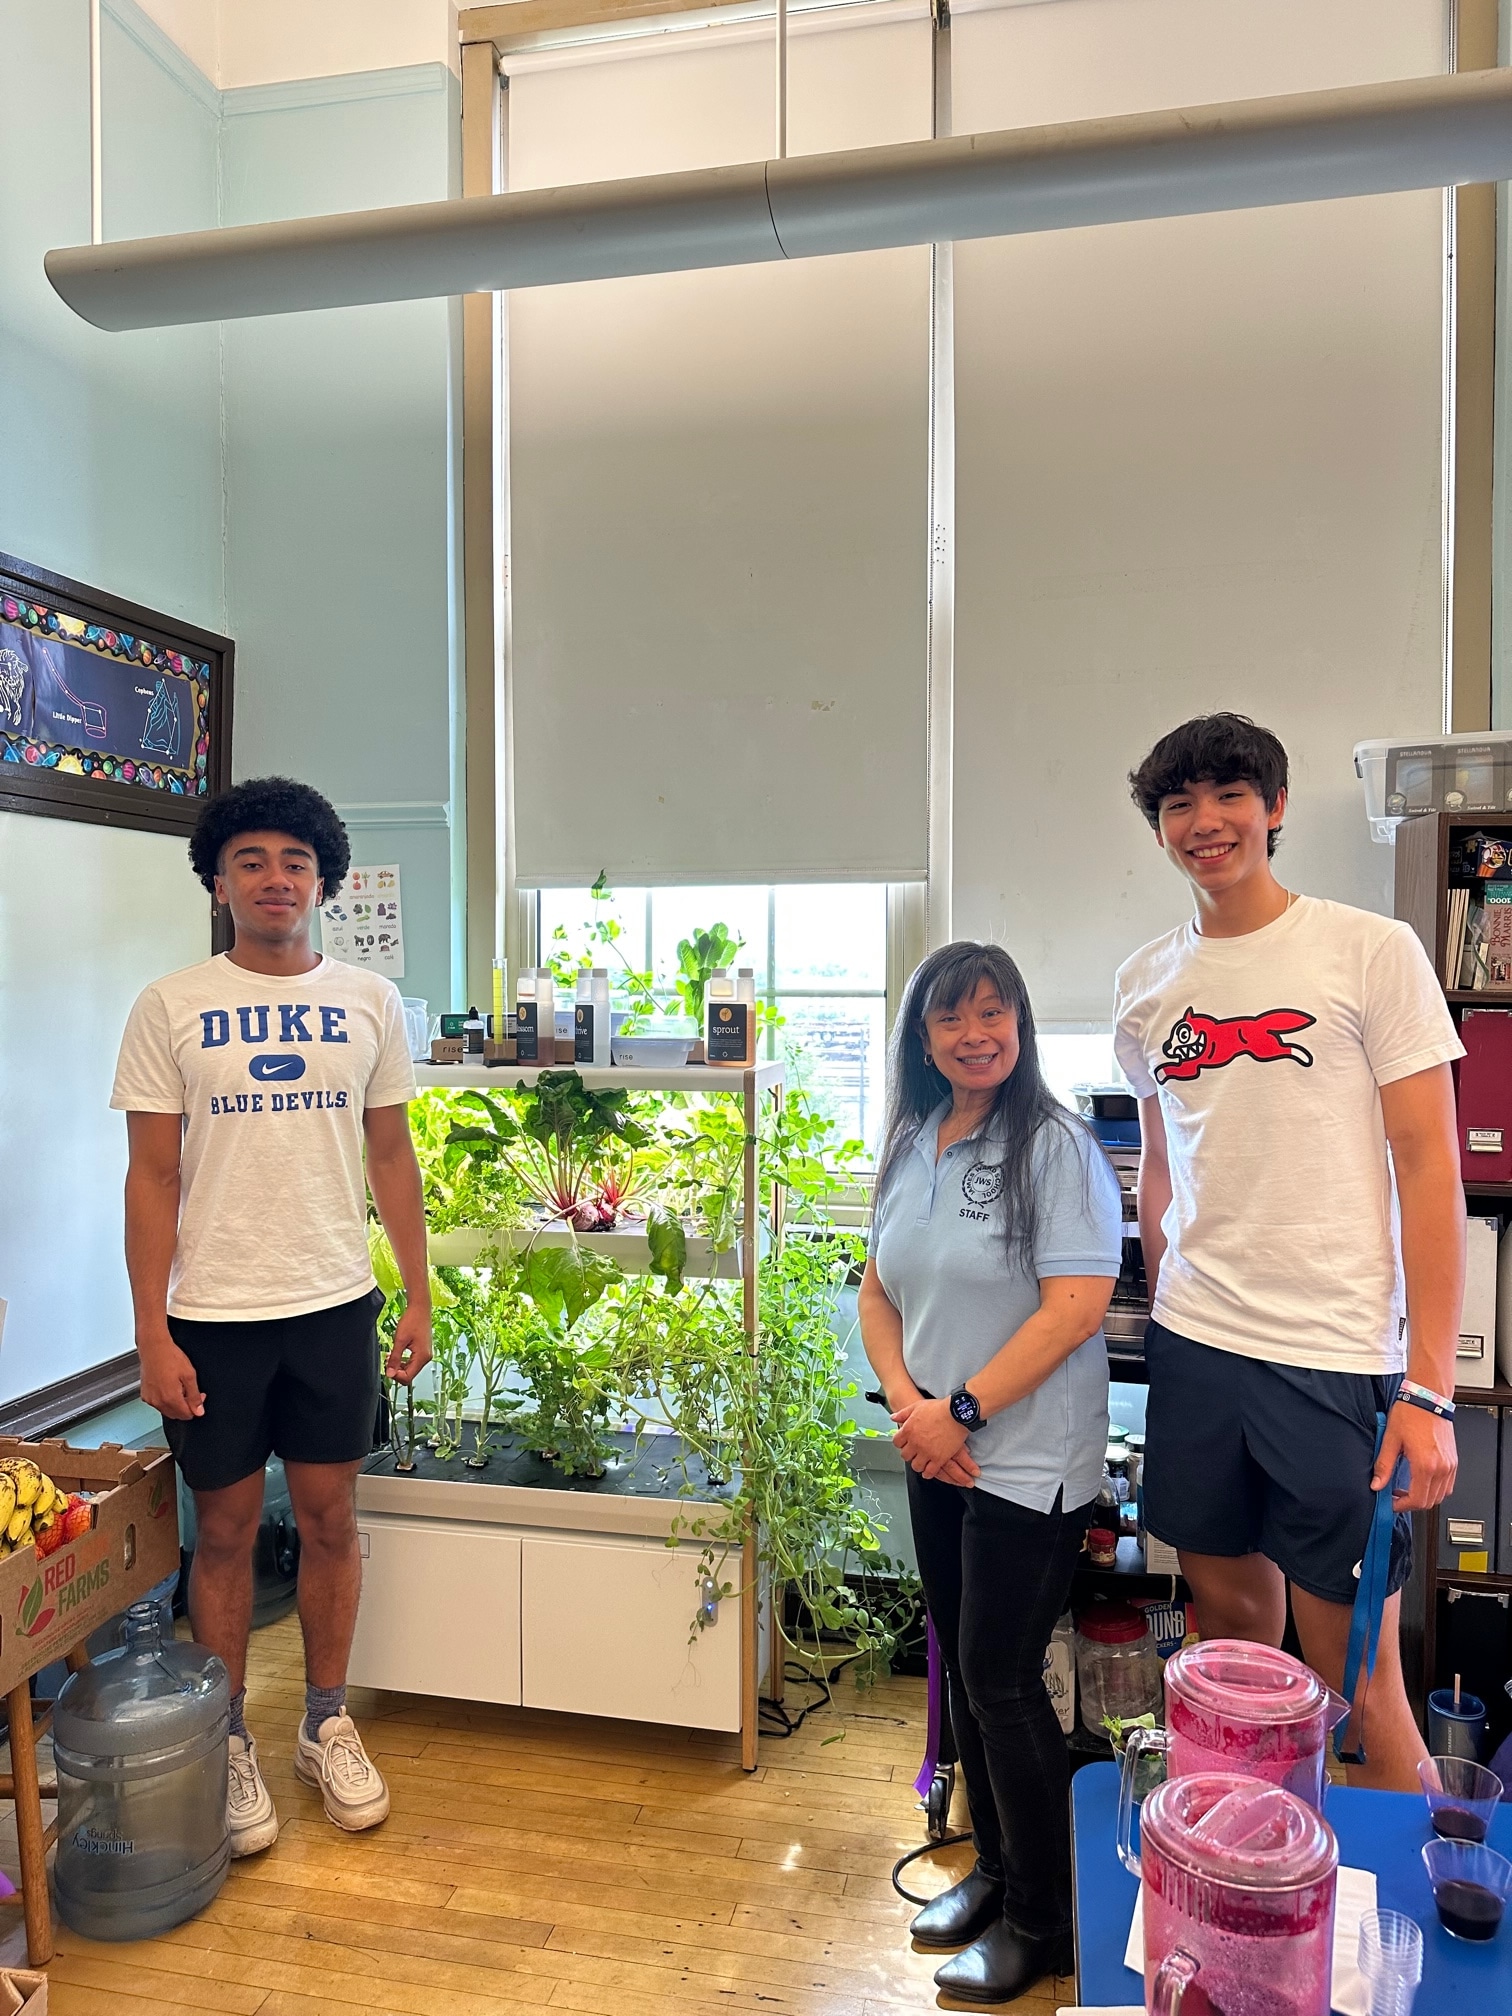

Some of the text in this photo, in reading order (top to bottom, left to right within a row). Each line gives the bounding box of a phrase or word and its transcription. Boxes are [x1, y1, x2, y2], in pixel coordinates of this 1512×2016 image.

[134, 686, 154, 696] Cepheus
[52, 712, 82, 724] Little Dipper
[1500, 907, 1512, 947] MARRIS
[200, 1004, 348, 1048] DUKE
[712, 1026, 740, 1035] sprout
[211, 1094, 263, 1114] BLUE
[966, 1165, 1001, 1198] JAMES WARD SCHOOL
[974, 1177, 991, 1186] JWS
[959, 1208, 990, 1222] STAFF
[44, 1553, 76, 1596] RED
[58, 1558, 110, 1616] FARMS
[1144, 1604, 1172, 1613] GOLDEN
[1146, 1610, 1185, 1641] OUND
[72, 1832, 134, 1855] Hinckley
[87, 1828, 122, 1840] Springs
